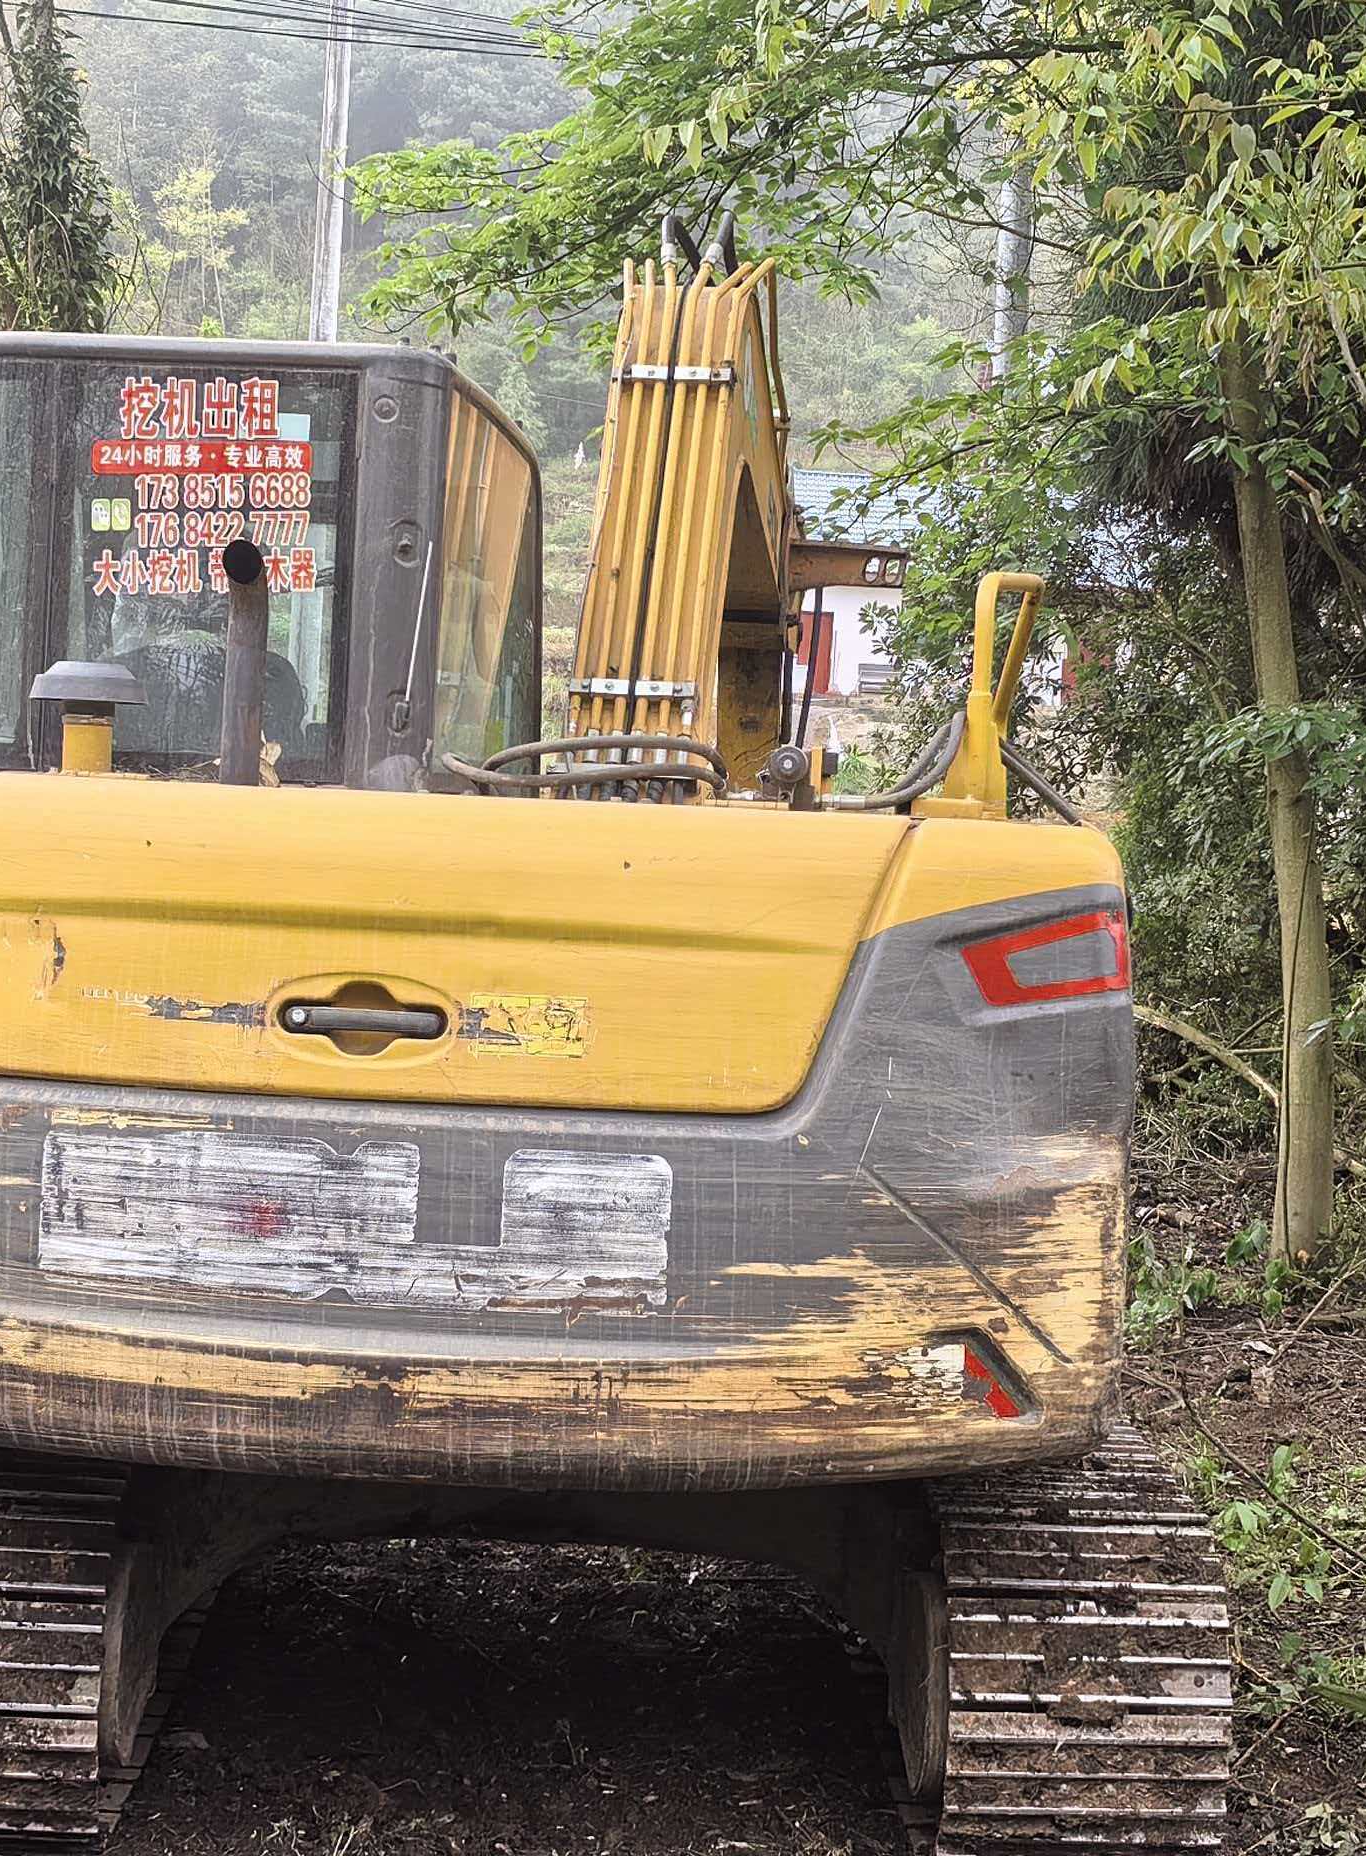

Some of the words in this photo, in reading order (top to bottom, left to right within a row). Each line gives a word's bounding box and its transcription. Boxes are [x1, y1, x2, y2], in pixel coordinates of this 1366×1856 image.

[121, 377, 279, 439] 挖机出租
[135, 475, 179, 509] 173
[184, 474, 244, 509] 8515
[249, 472, 311, 508] 6688
[135, 512, 179, 548] 176
[184, 512, 245, 547] 8422
[249, 511, 310, 546] 7777
[93, 549, 202, 595] 大小挖机
